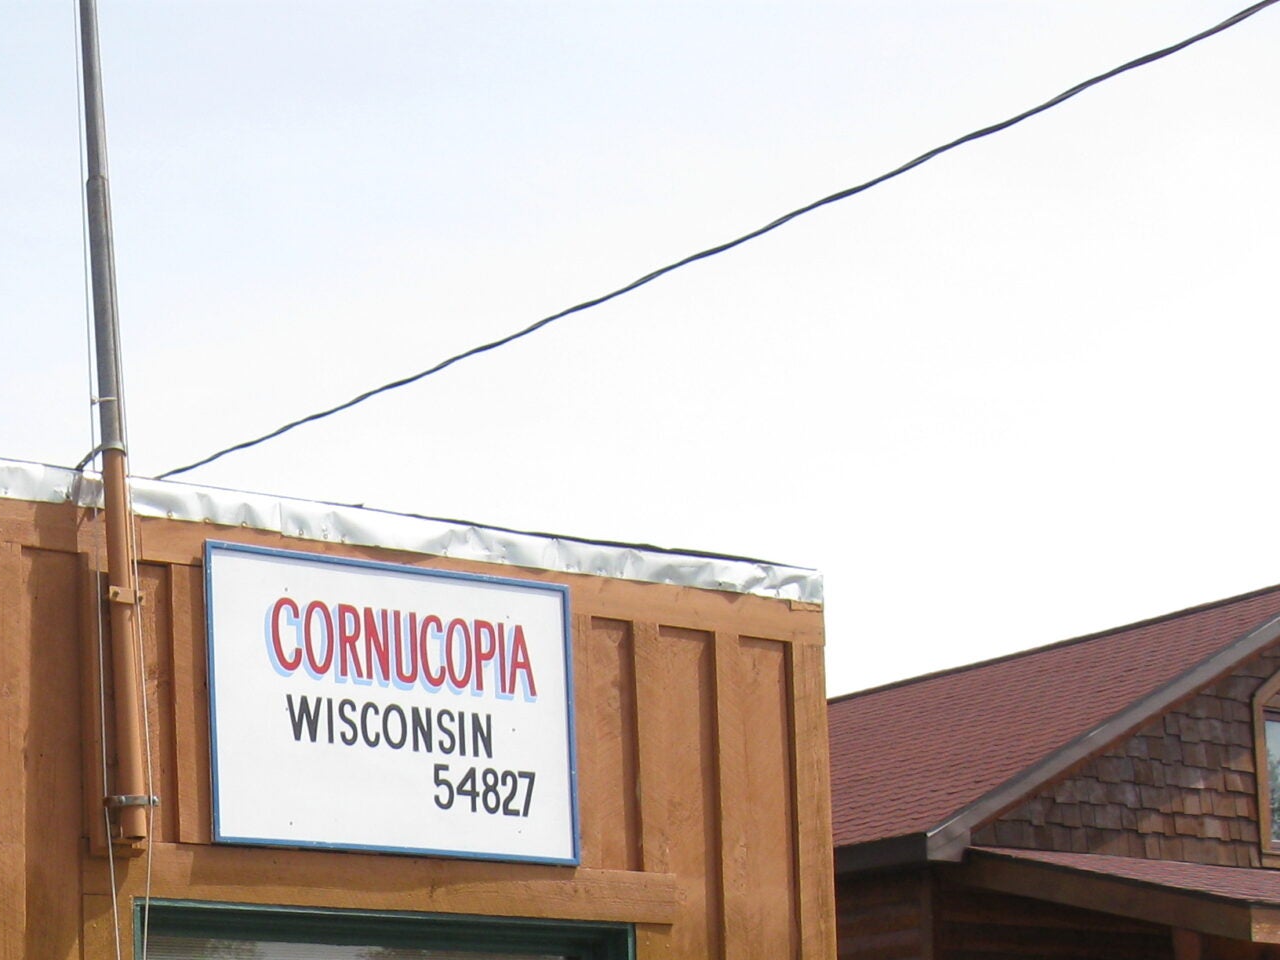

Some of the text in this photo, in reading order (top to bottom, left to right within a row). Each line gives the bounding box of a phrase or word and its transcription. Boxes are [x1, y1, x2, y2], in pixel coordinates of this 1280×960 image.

[265, 598, 538, 702] CORNUCOPIA
[285, 693, 494, 759] WISCONSIN
[433, 763, 536, 818] 54827
